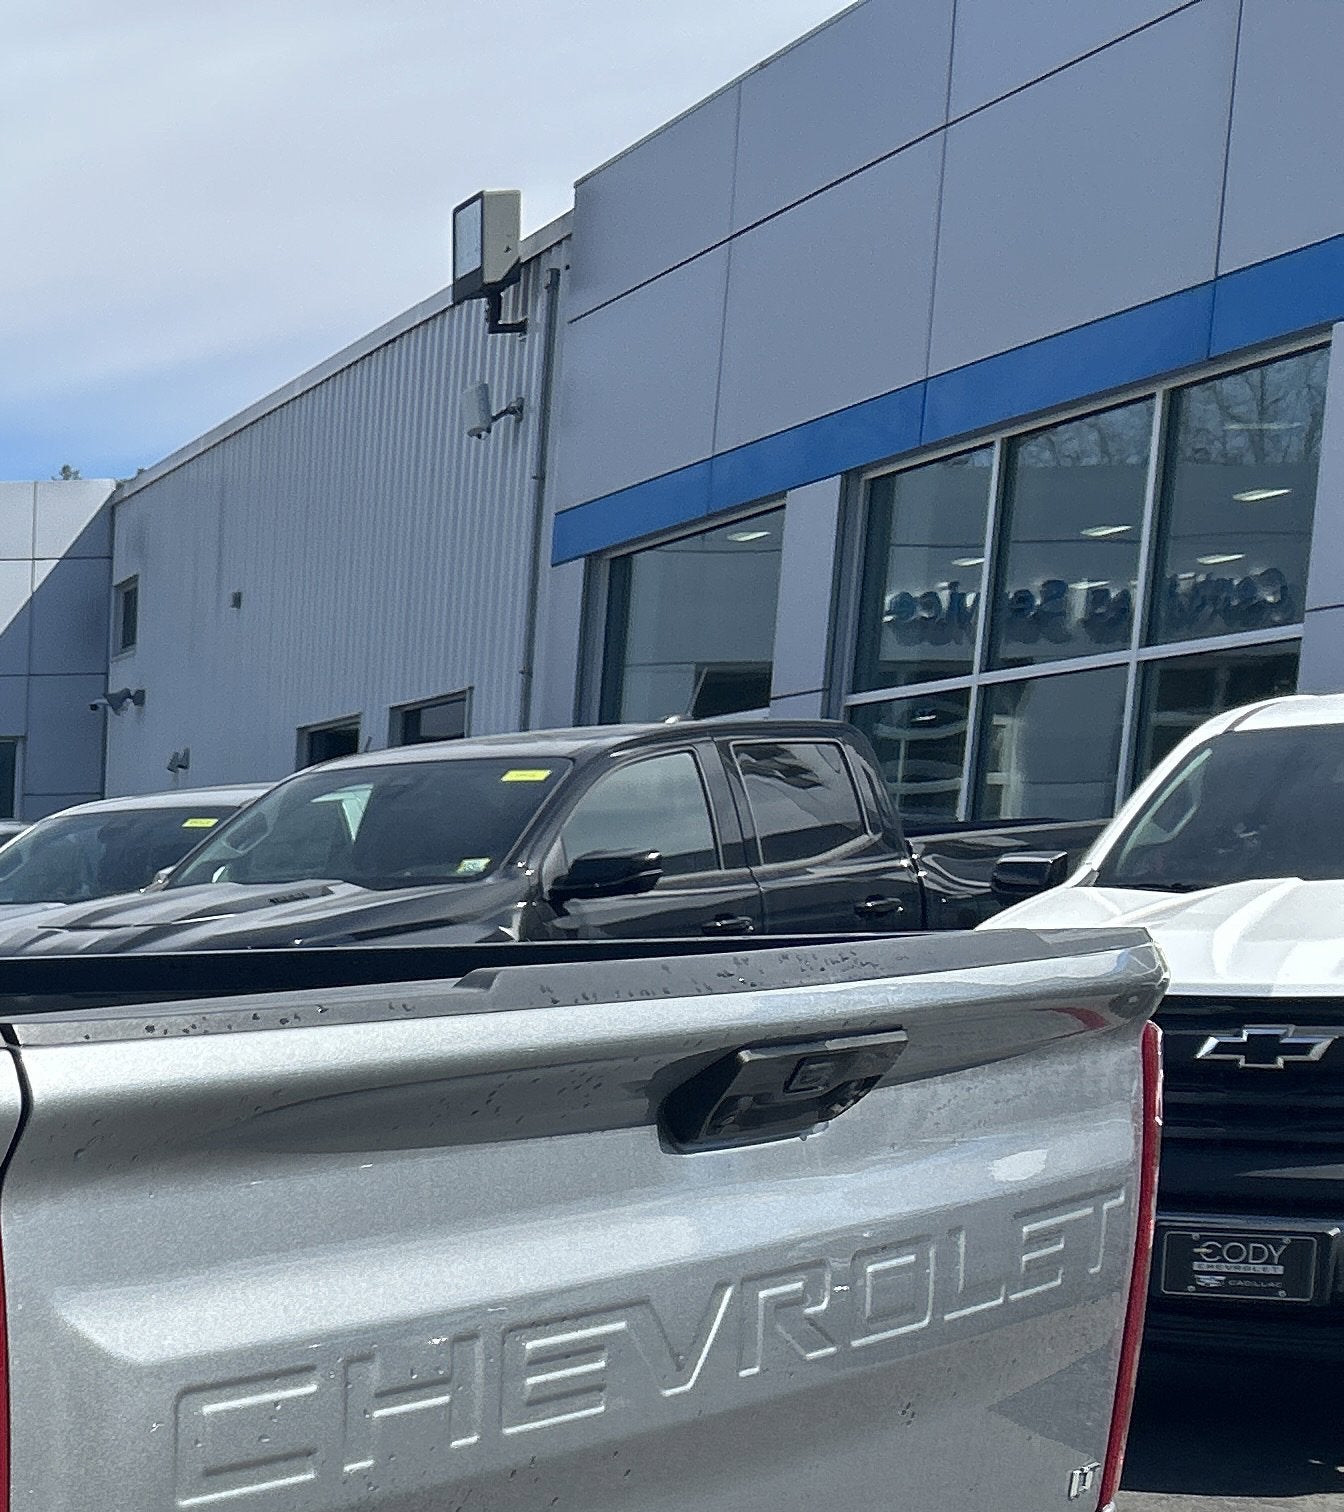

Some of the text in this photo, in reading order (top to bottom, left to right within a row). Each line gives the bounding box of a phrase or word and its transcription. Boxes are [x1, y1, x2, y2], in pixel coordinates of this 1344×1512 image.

[1193, 1241, 1287, 1263] CODY
[1197, 1263, 1282, 1273] CHEVROLET
[174, 1187, 1126, 1508] CHEVROLET
[1069, 1461, 1101, 1500] LT
